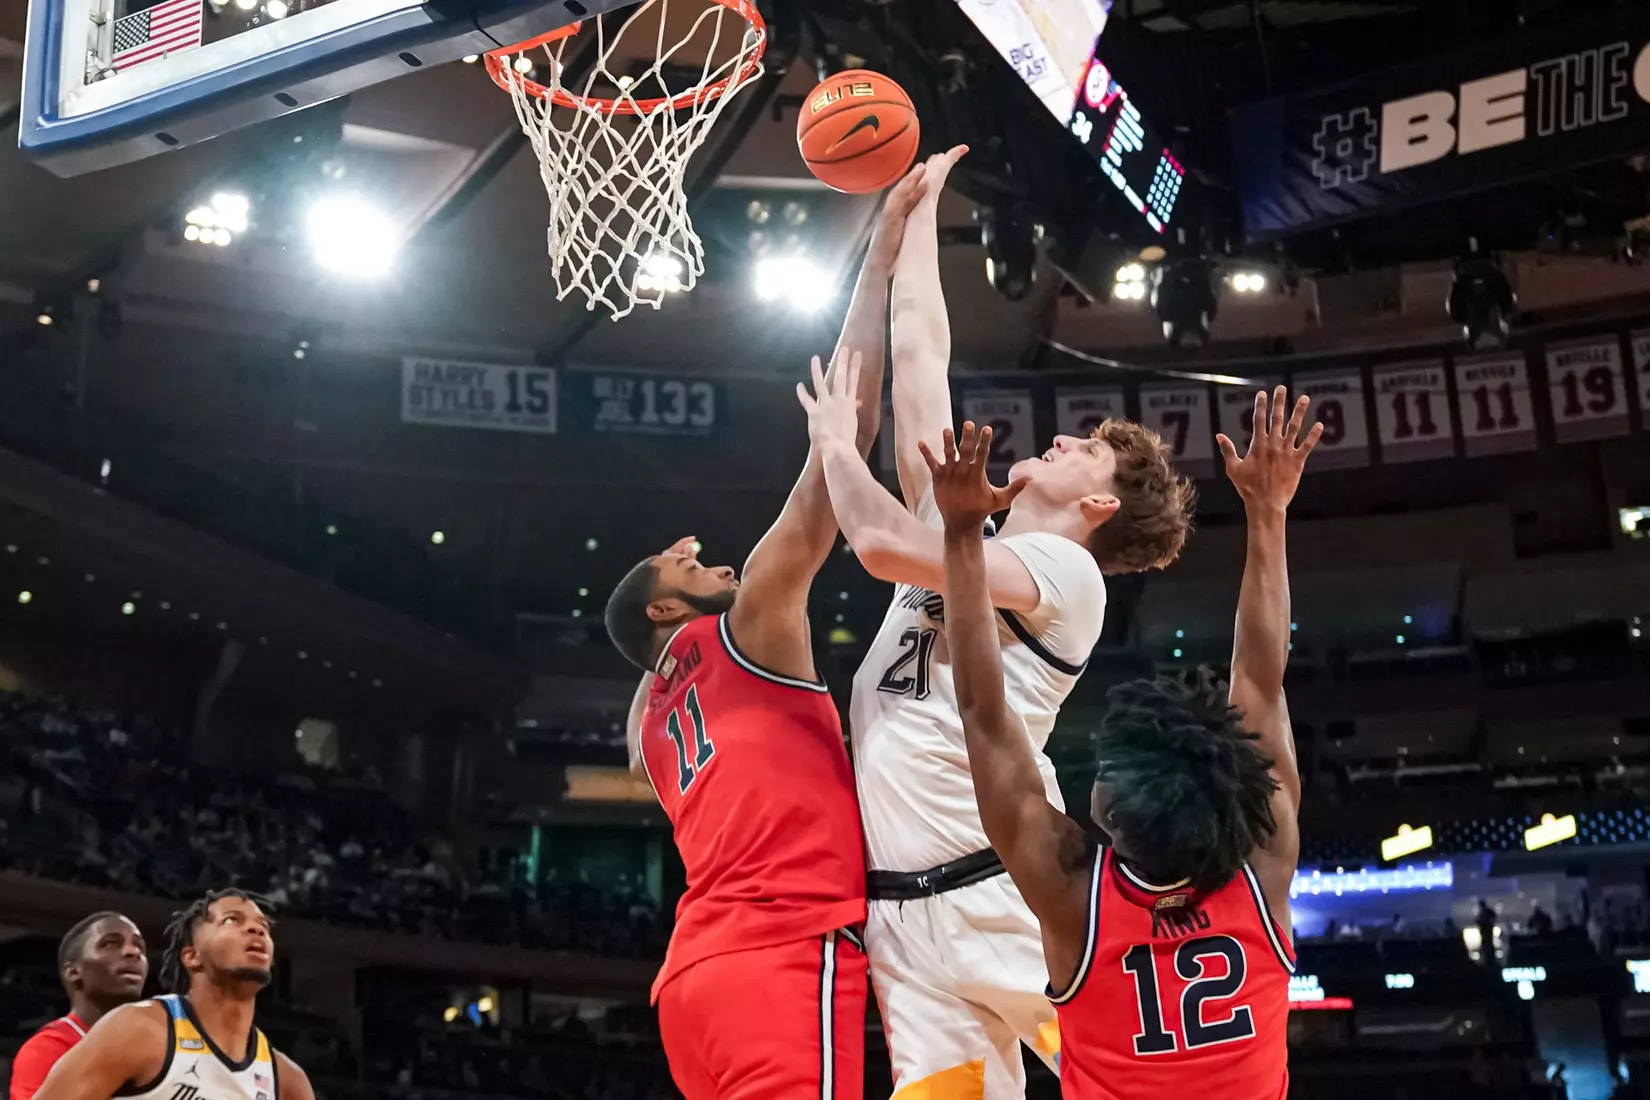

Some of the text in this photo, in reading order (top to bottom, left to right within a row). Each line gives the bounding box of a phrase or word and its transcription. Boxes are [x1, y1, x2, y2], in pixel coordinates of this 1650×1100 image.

[1009, 43, 1034, 65] BIG
[810, 82, 875, 115] ELITE
[506, 370, 550, 414] 15
[640, 379, 716, 426] 133
[1473, 381, 1519, 431] 11
[1562, 365, 1616, 417] 19
[1162, 411, 1190, 457] 7
[1316, 399, 1345, 445] 9
[1392, 391, 1437, 439] 11
[988, 418, 1014, 463] 2
[876, 626, 937, 700] 21
[666, 682, 715, 796] 11
[1121, 934, 1256, 1056] 12
